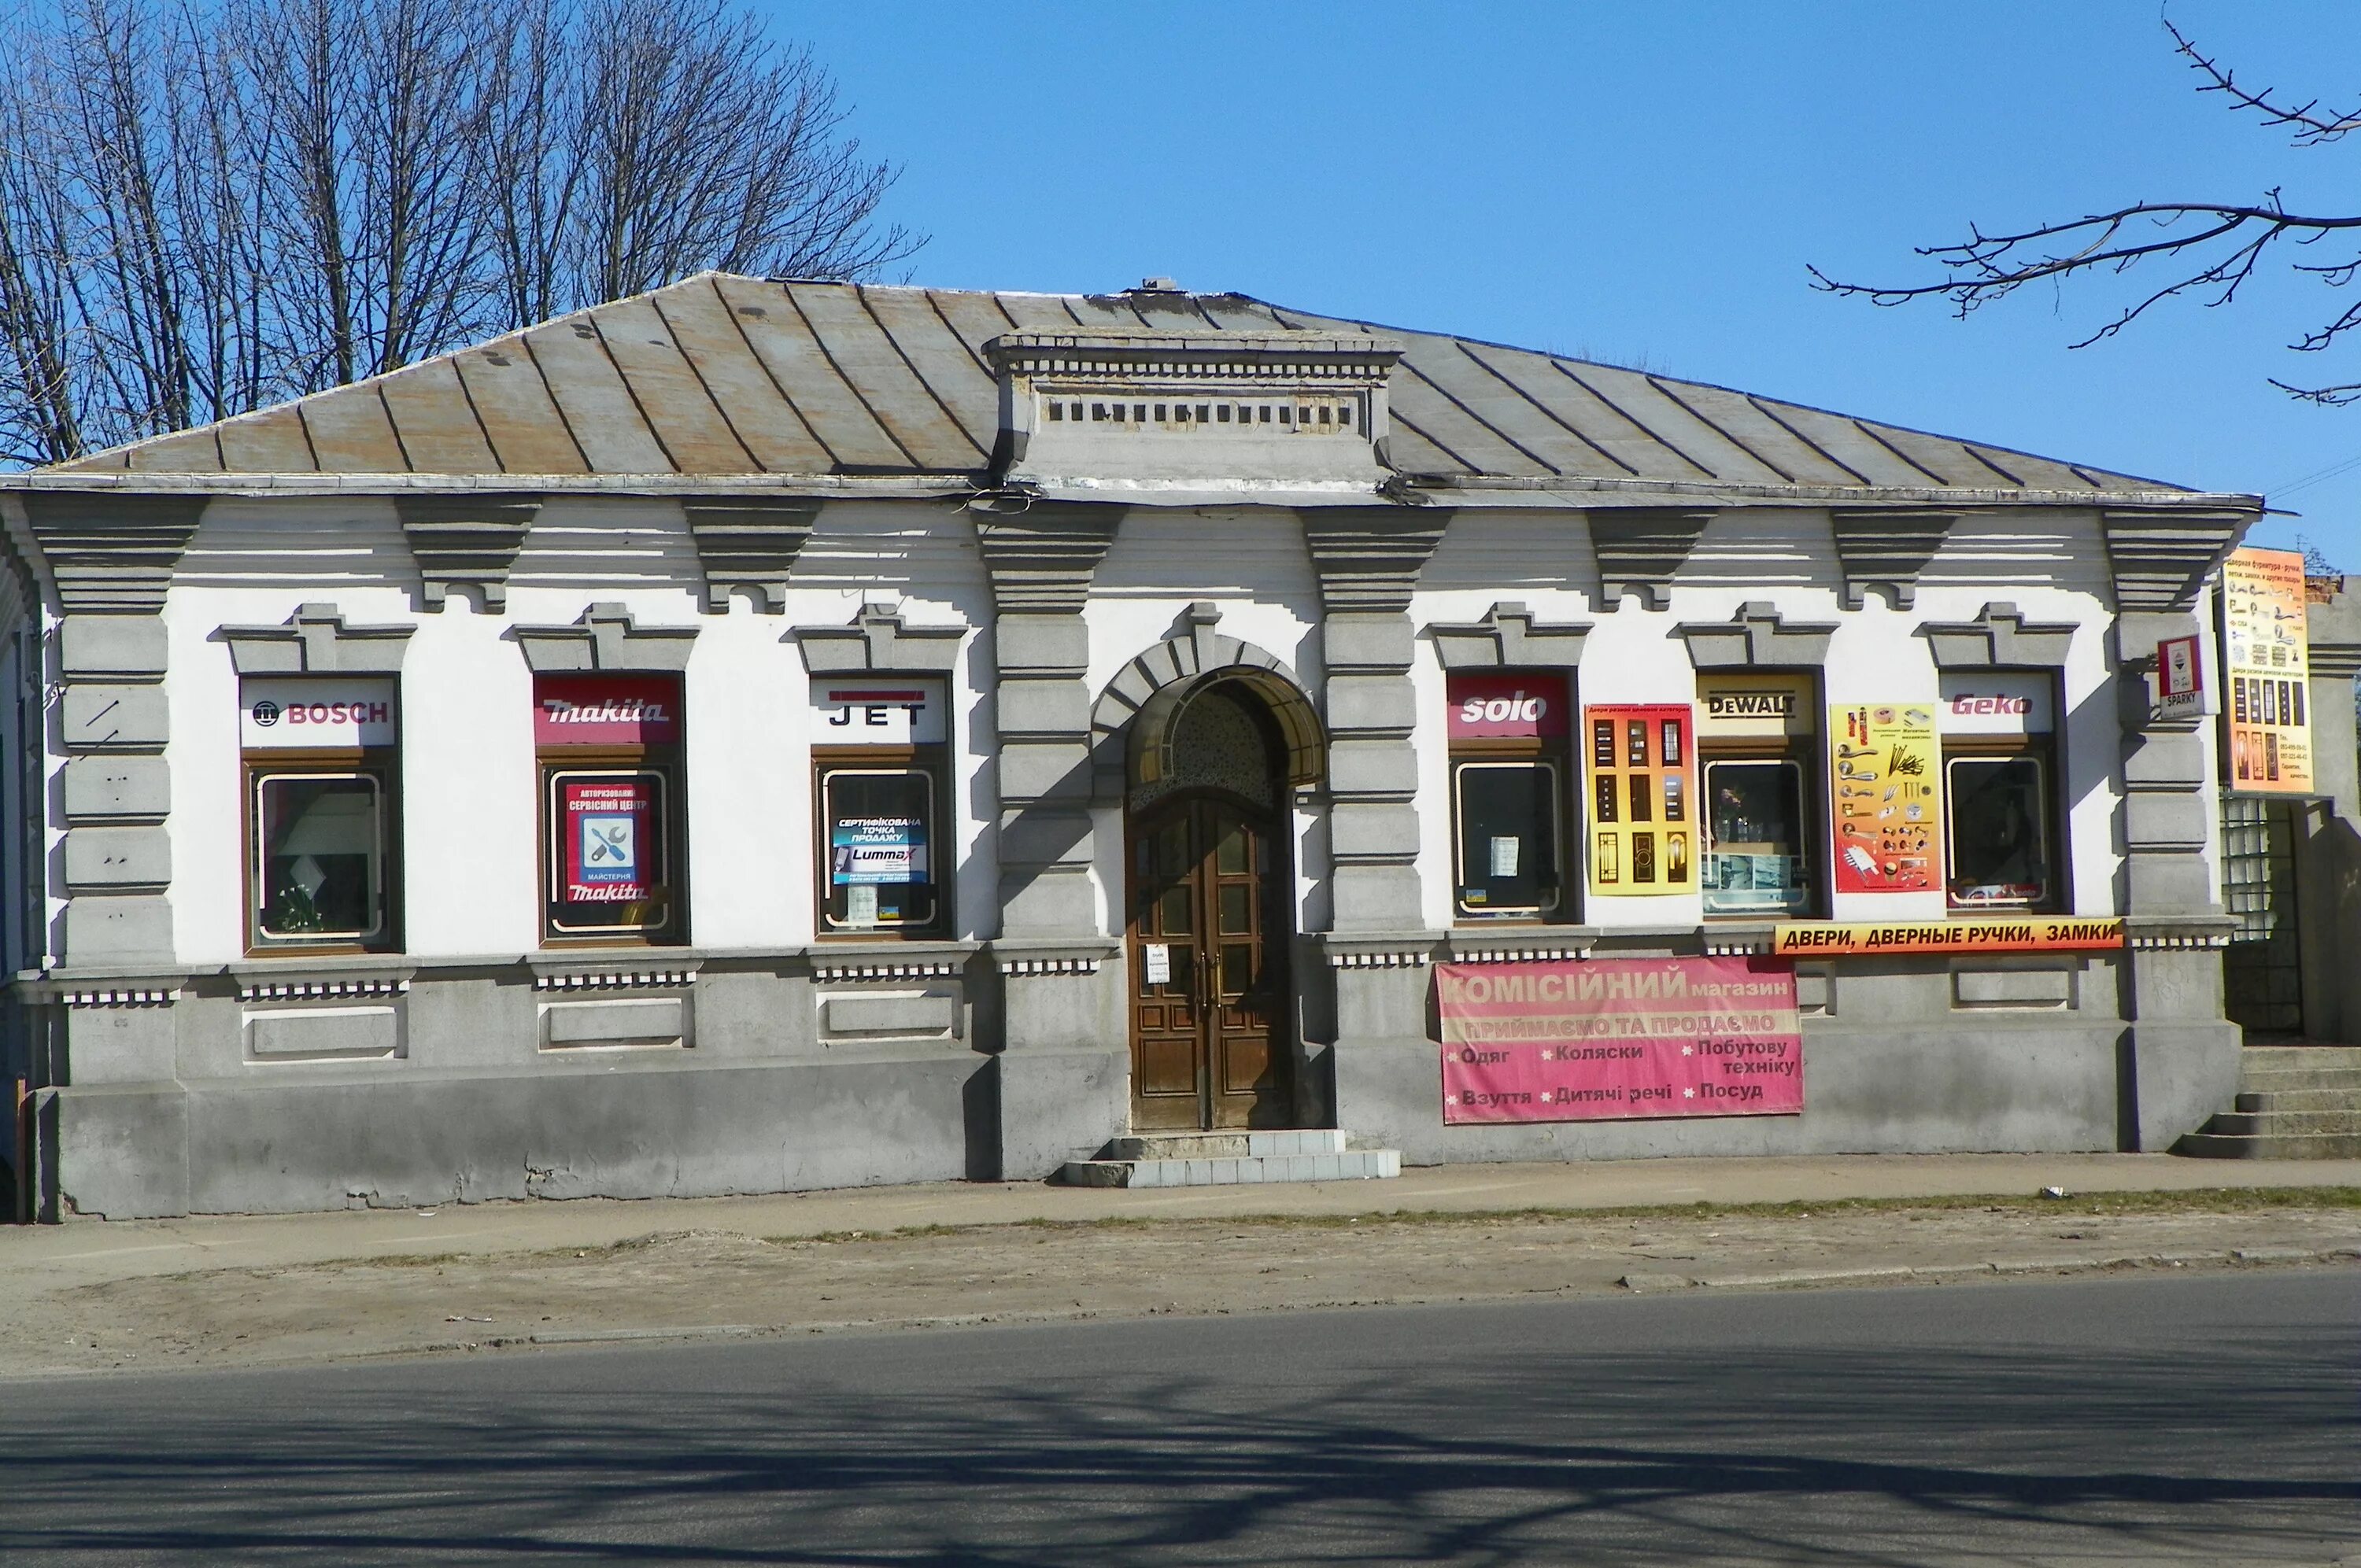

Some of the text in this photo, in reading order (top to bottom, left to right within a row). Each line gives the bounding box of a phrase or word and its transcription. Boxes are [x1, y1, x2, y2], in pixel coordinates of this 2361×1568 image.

[1461, 690, 1547, 722] solo
[1952, 694, 2033, 714] Geko
[2167, 692, 2196, 707] SPARKY
[288, 702, 388, 725] BOSCH
[544, 699, 670, 723] Makita
[829, 704, 926, 725] JET
[569, 799, 647, 811] СЕРВІСНИЙ ЦЕНТР
[839, 817, 922, 828] СЕРТИФІКОВАНА
[1783, 924, 2116, 950] ДВЕРИ, ДВЕРНЫЕ РУЧКИ, ЗАМКИ
[1443, 965, 1788, 1004] КОМІСІЙНИЙ магазин
[1465, 1015, 1776, 1039] ПРИЙМАЄМО ТА ПРОДАЄМО
[1461, 1047, 1510, 1066] Одяг
[1556, 1046, 1643, 1061] Коляски
[1698, 1039, 1787, 1057] Побутову
[1724, 1059, 1795, 1076] техніку
[1462, 1090, 1532, 1108] Взуття
[1555, 1084, 1672, 1105] Дитячі речі
[1701, 1083, 1764, 1101] Посуд
